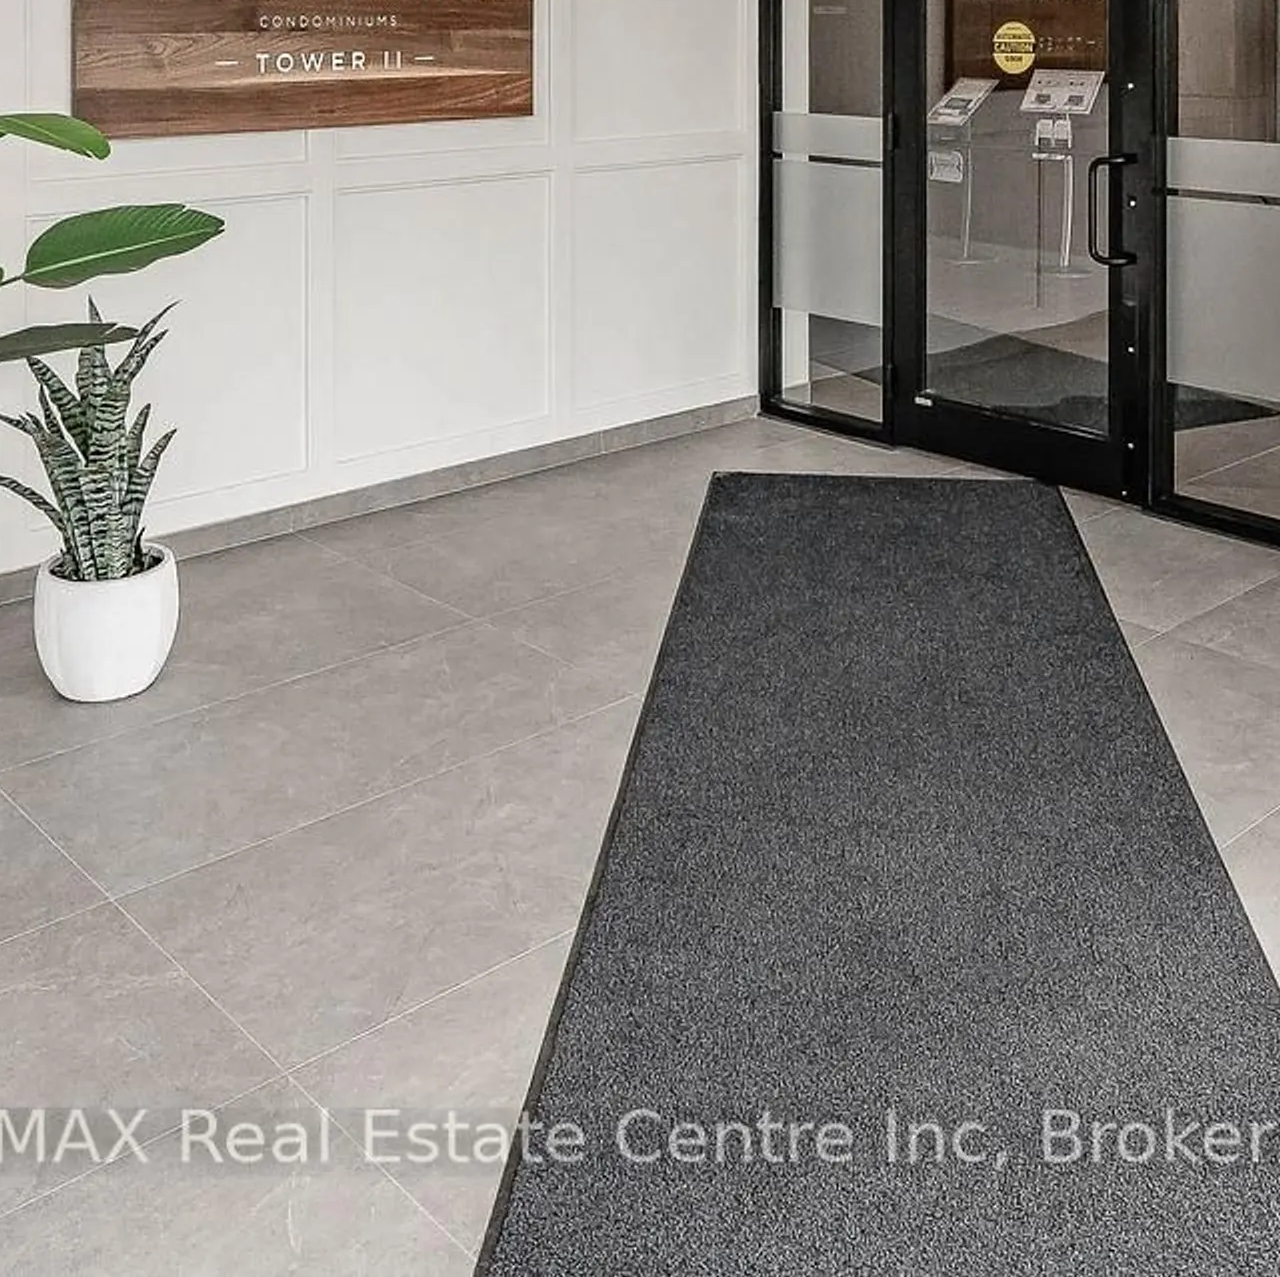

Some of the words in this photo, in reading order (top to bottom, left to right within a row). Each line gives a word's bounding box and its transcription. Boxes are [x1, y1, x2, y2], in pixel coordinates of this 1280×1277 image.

[259, 14, 398, 29] CONDOMINIUMS
[256, 51, 366, 74] TOWER
[383, 50, 402, 70] II
